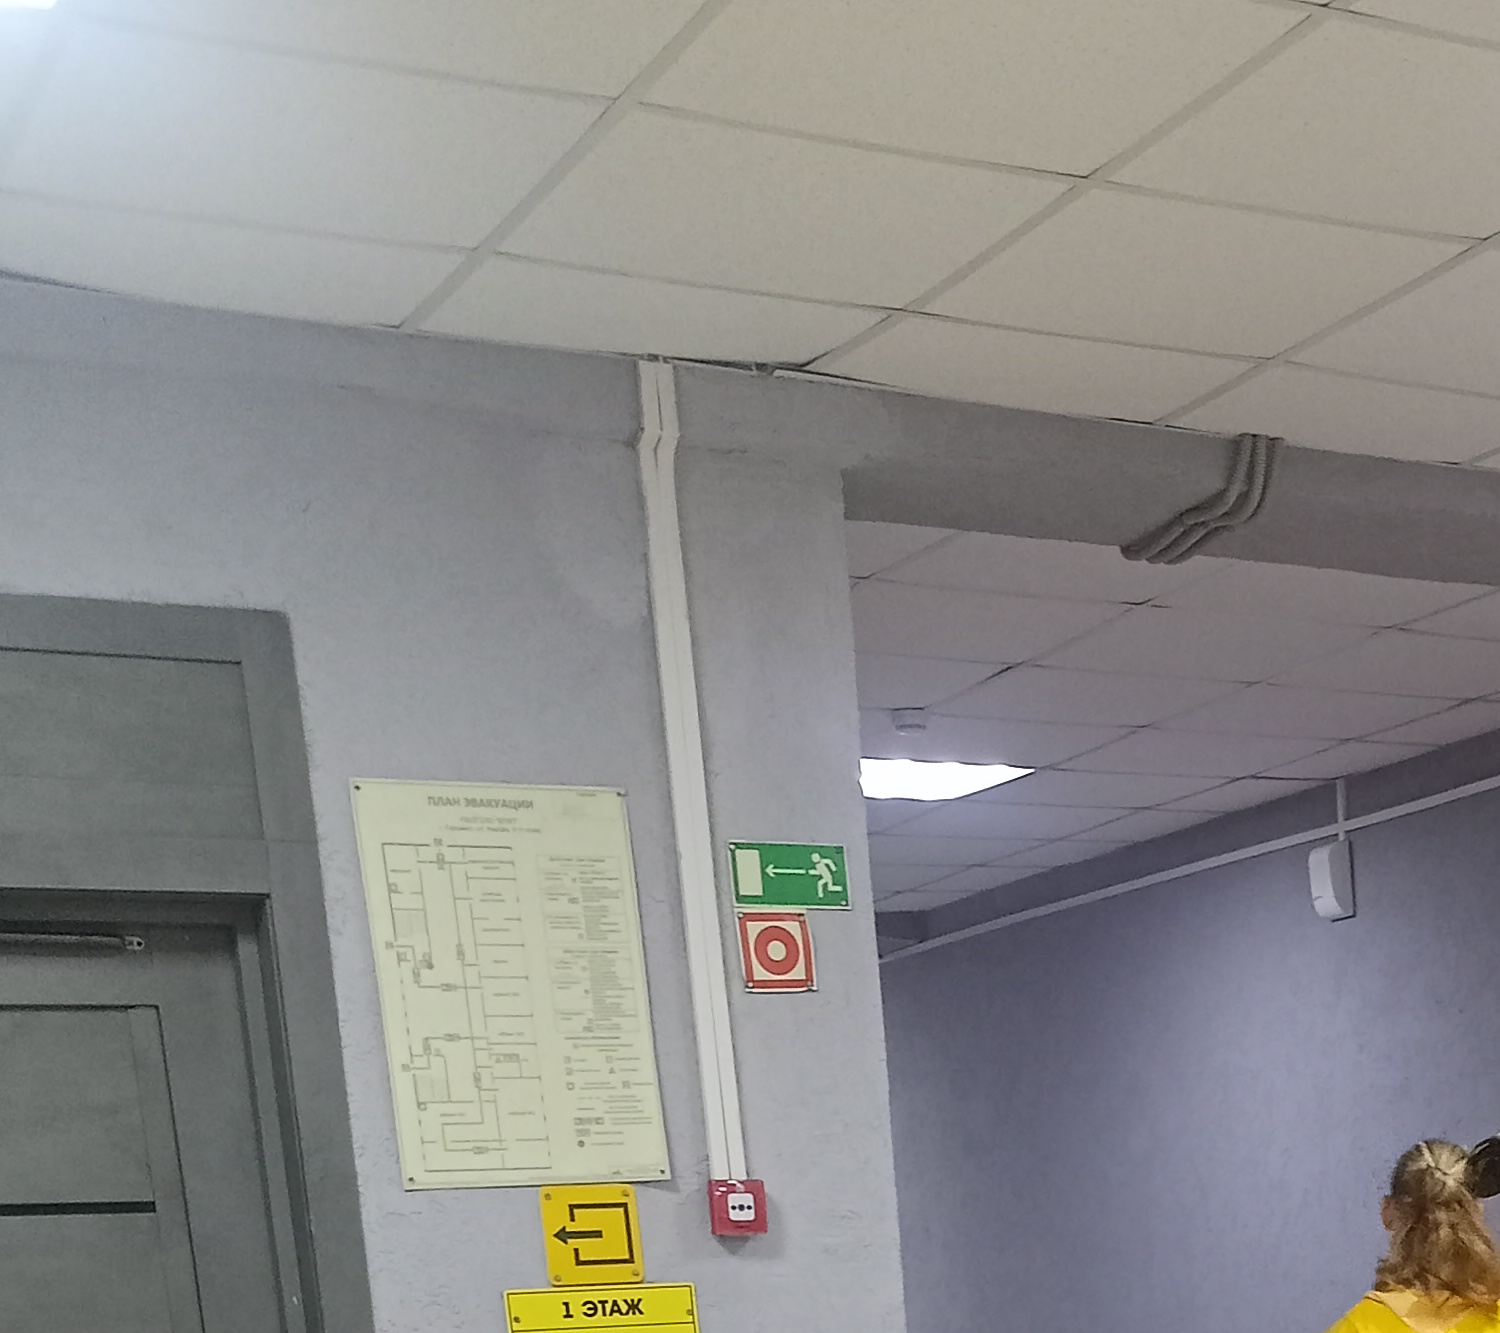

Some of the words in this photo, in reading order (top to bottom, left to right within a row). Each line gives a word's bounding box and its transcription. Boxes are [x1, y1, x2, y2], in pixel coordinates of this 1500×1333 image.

[427, 795, 461, 807] ПЛАН
[463, 797, 534, 811] ЭВАКУАЦИИ
[562, 1301, 574, 1319] 1
[581, 1298, 645, 1317] ЭТАЖ
